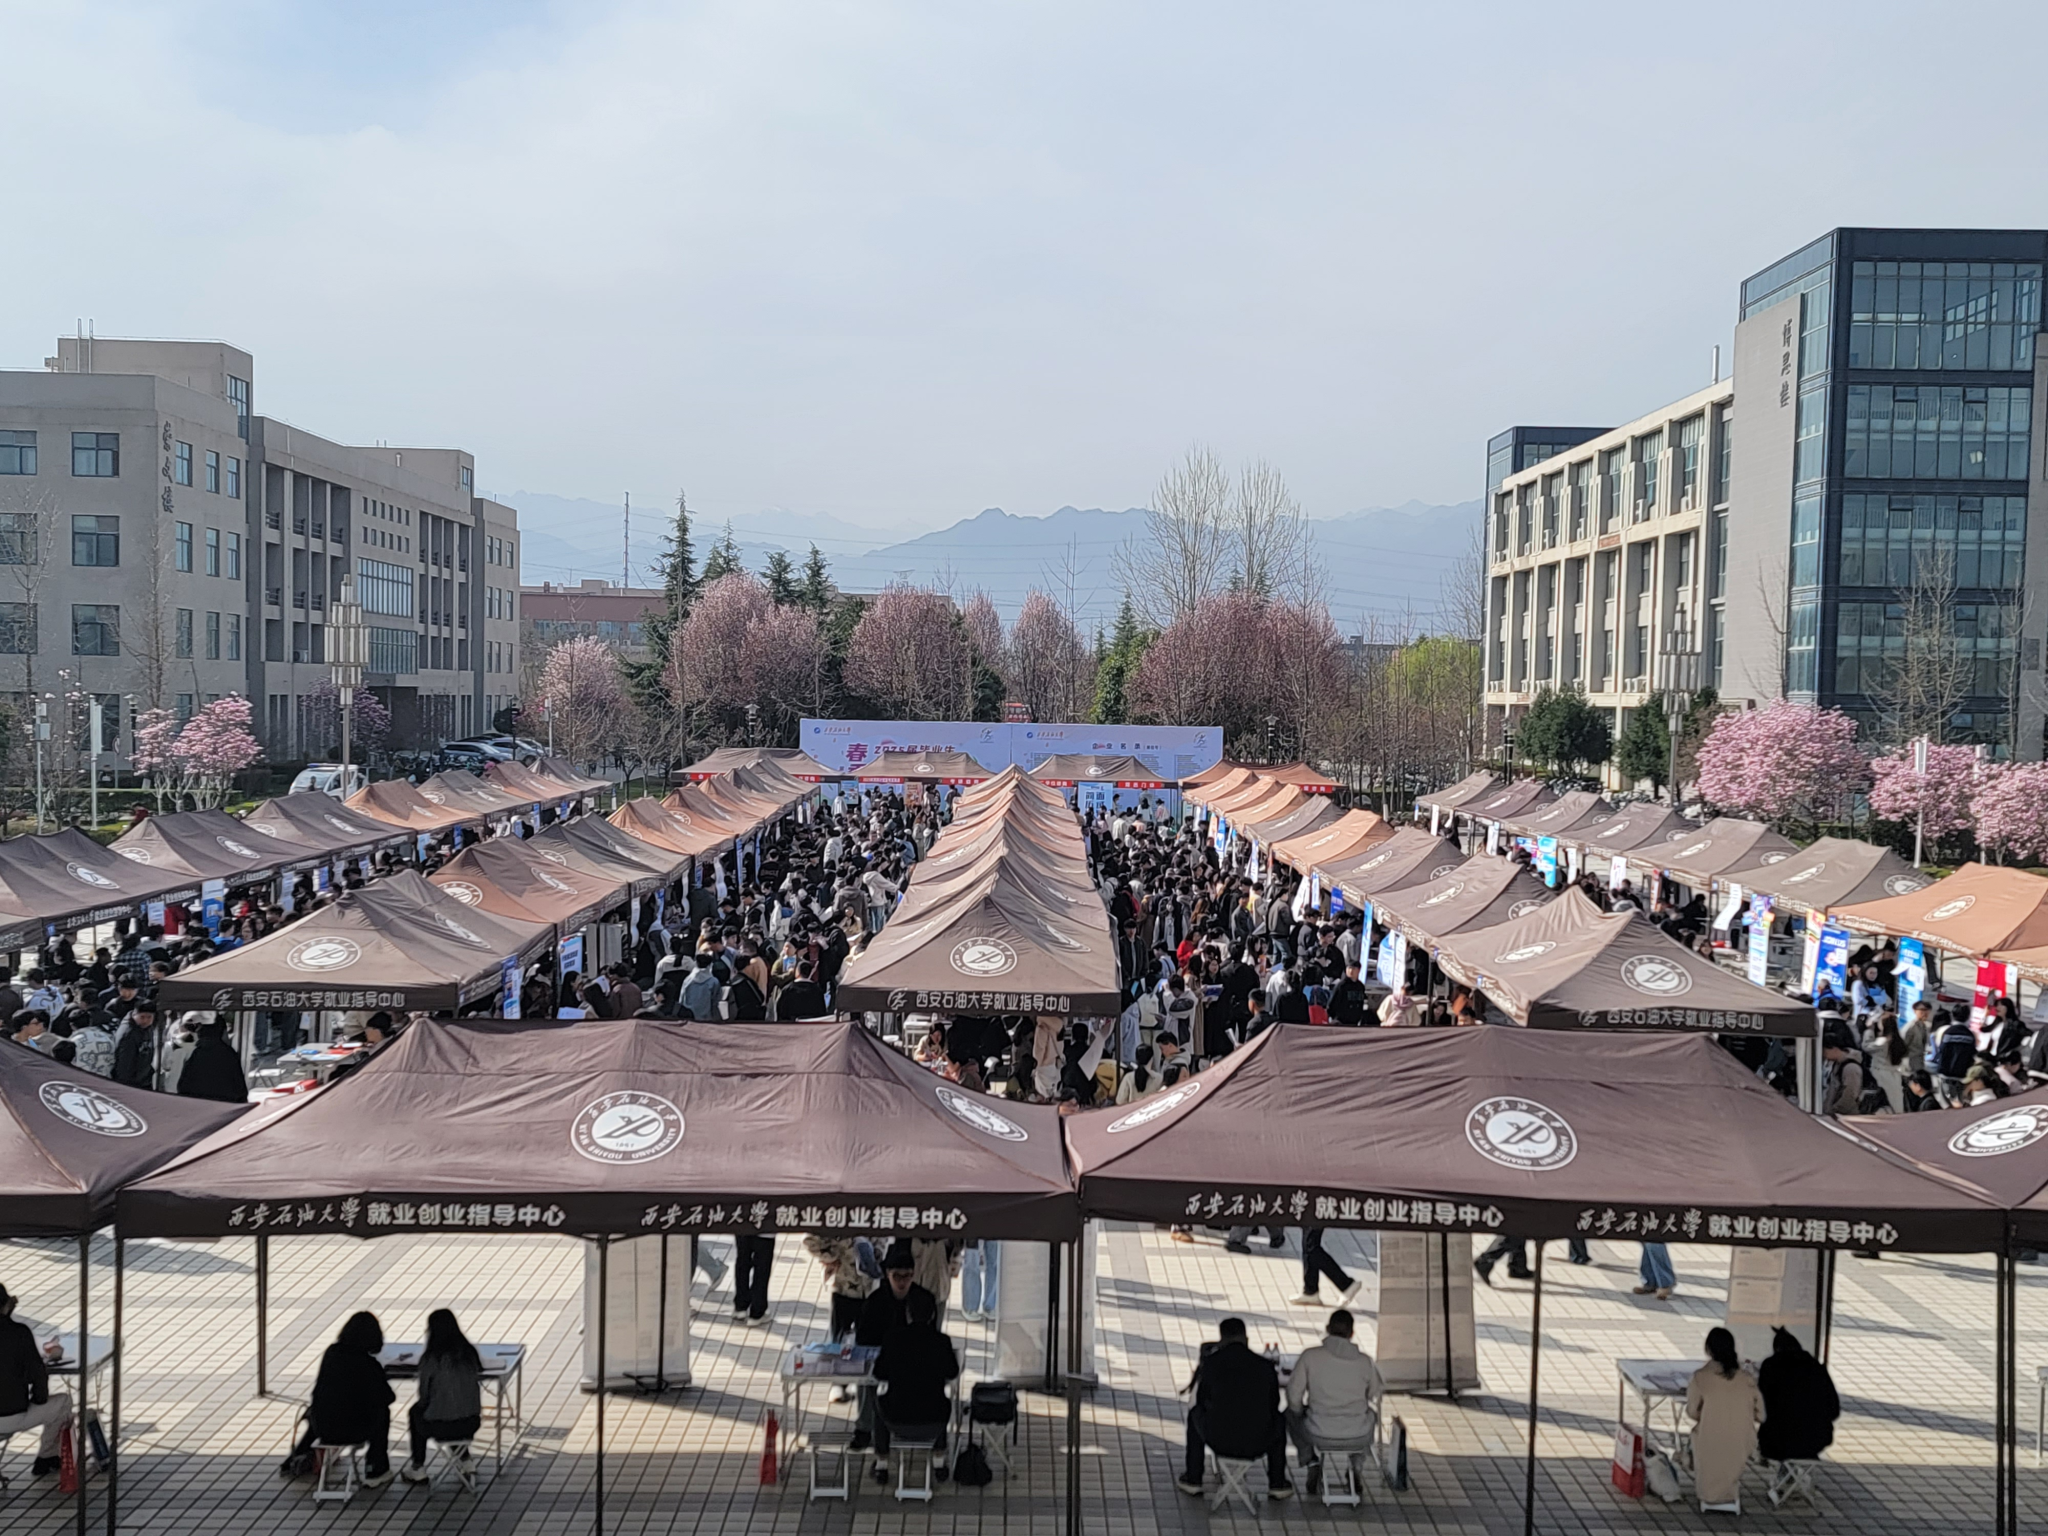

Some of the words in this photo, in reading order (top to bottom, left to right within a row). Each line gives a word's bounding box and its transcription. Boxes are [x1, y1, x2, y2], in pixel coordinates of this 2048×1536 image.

[242, 990, 405, 1008] 西安石油大学就业指导中心
[916, 990, 1070, 1013] 西安石油大学就业指导中心
[1607, 1009, 1765, 1030] 西安石油大学就业指导中心
[366, 1203, 567, 1227] 就业创业指导中心
[774, 1205, 968, 1231] 就业创业指导中心
[1314, 1197, 1505, 1228] 就业创业指导中心
[1707, 1214, 1899, 1245] 就业创业指导中心
